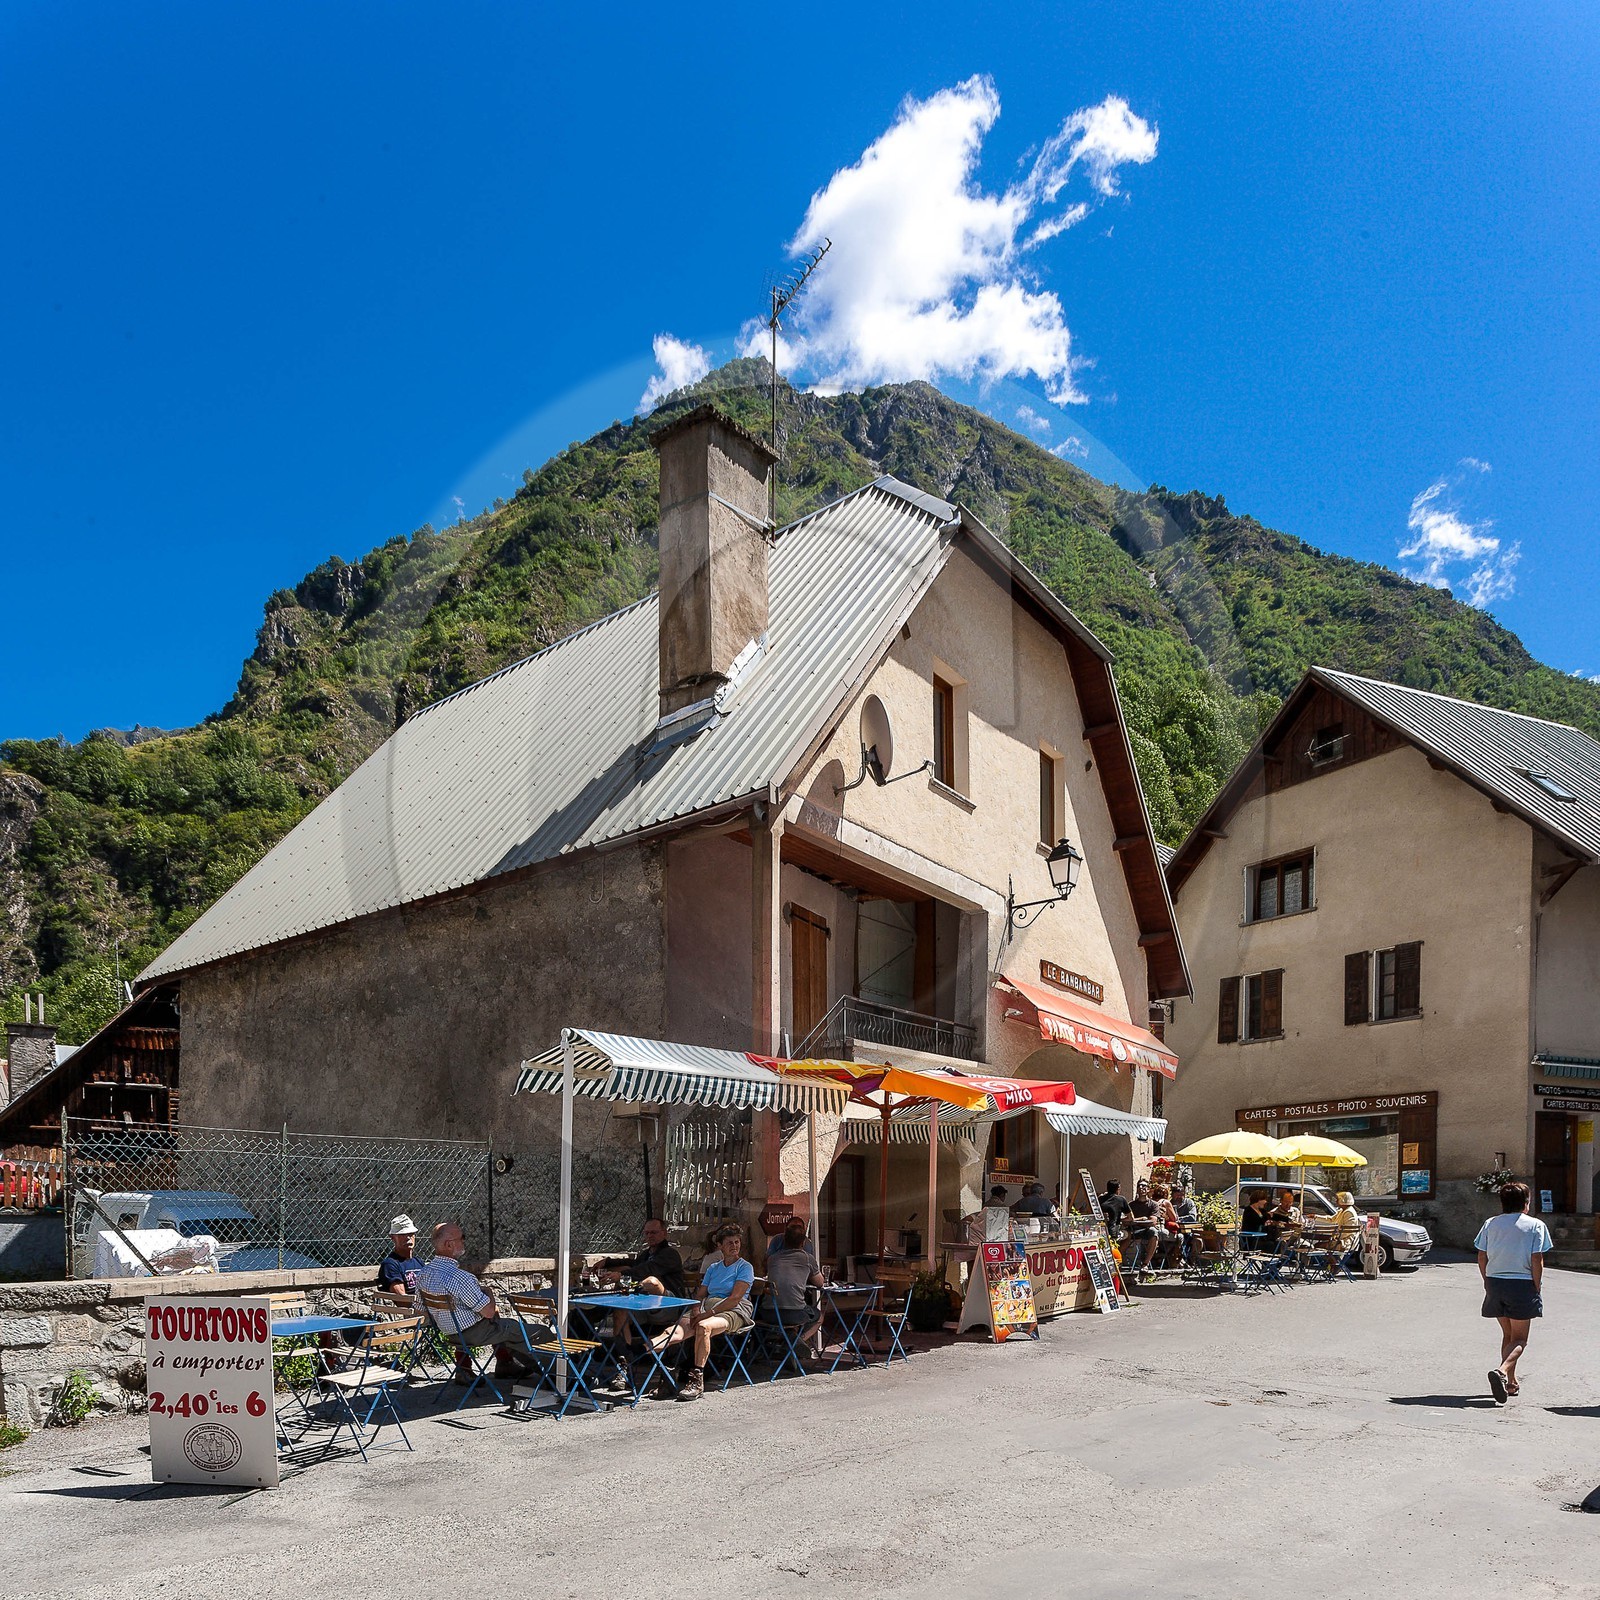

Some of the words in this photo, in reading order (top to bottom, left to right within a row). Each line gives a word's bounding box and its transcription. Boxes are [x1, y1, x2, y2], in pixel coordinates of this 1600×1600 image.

[1047, 964, 1056, 980] LE
[1005, 1088, 1032, 1106] MIKO
[1244, 1108, 1277, 1120] CARTES
[1284, 1103, 1329, 1116] POSTALES
[1337, 1100, 1367, 1112] PHOTO
[1375, 1094, 1427, 1109] SOUVENIRS
[995, 1159, 1008, 1170] BAR
[1027, 1246, 1097, 1277] OURTON
[148, 1306, 268, 1343] TOURTONS
[152, 1351, 165, 1369] à
[172, 1355, 265, 1377] emporter
[216, 1402, 239, 1414] les
[246, 1391, 267, 1417] 6
